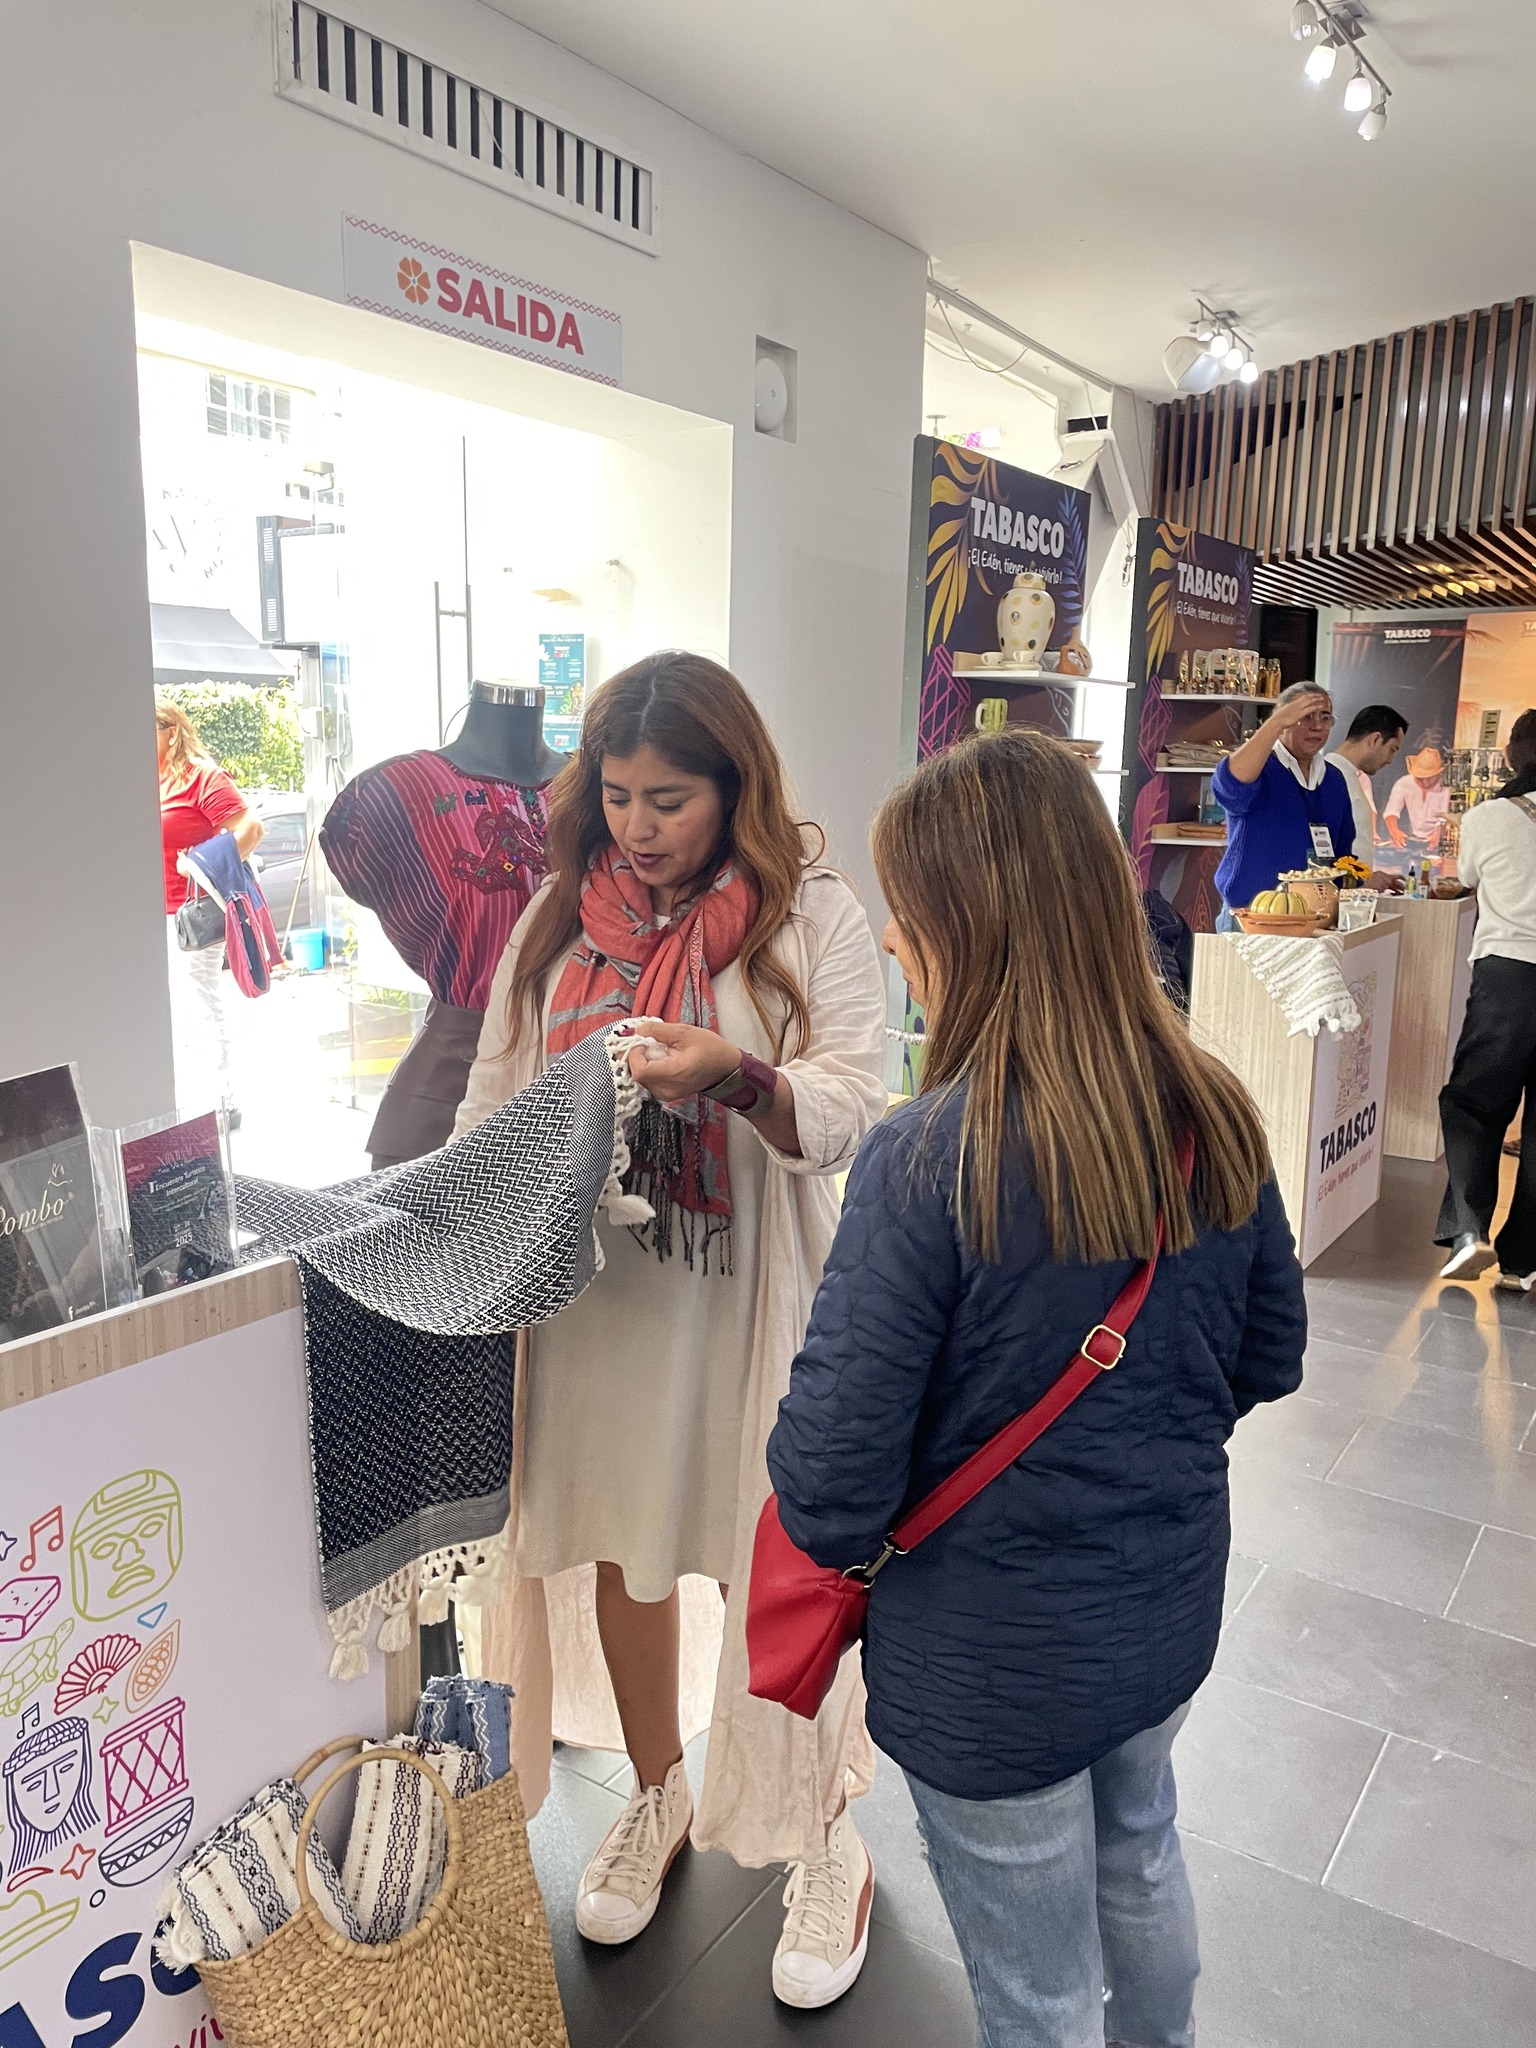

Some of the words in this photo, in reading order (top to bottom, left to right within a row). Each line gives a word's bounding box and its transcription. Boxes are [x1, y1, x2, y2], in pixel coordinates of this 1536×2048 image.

[436, 267, 585, 356] SALIDA
[970, 496, 1065, 559] TABASCO
[1177, 561, 1239, 606] TABASCO
[1384, 628, 1432, 639] TABASCO
[1320, 1101, 1377, 1175] TABASCO
[155, 1174, 184, 1192] Encuentro
[175, 1231, 193, 1248] 2025
